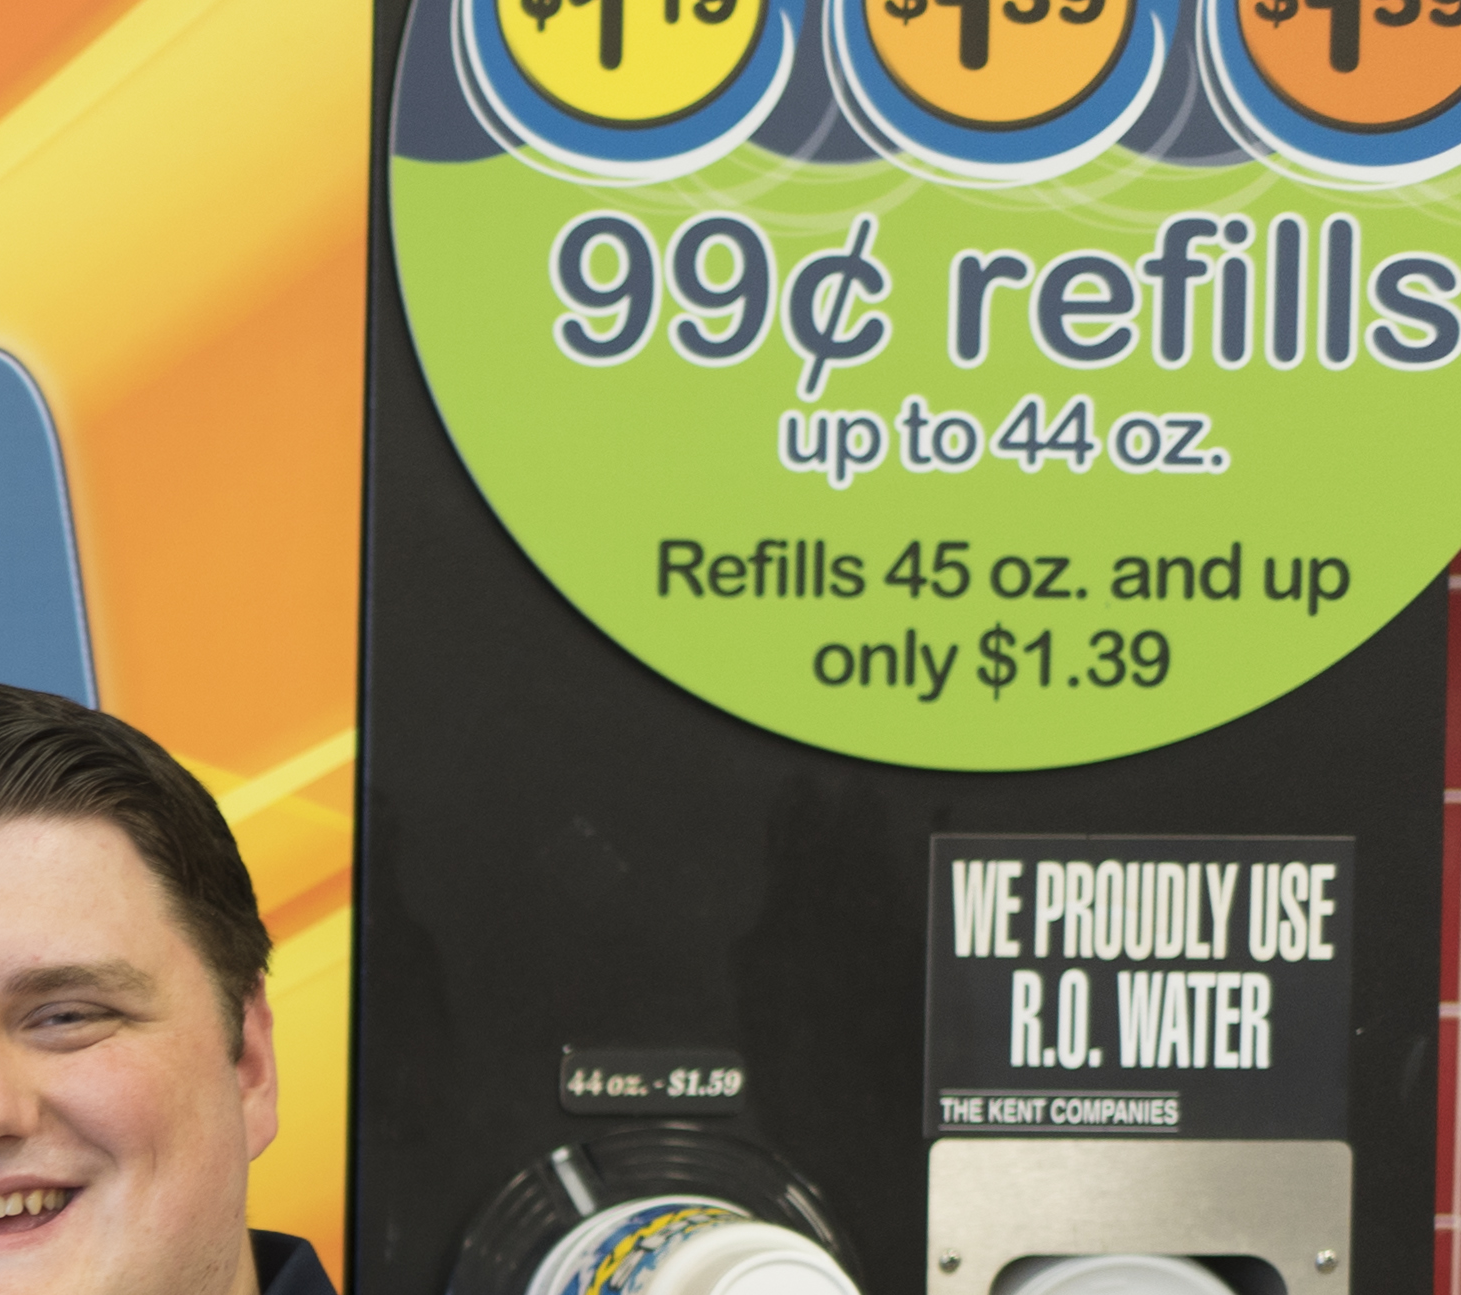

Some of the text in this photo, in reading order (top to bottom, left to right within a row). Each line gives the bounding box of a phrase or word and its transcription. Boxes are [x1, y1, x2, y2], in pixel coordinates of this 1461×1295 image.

[557, 216, 1461, 395] 99¢ refills
[787, 400, 1224, 482] up to 44 oz.
[657, 538, 1351, 617] Refills 45 oz. and up
[813, 624, 1173, 703] only $1.39
[951, 859, 1336, 963] WE PROUDLY USE
[1010, 969, 1272, 1071] R.O. WATER
[567, 1066, 606, 1098] 44
[607, 1074, 649, 1099] oz.
[667, 1066, 743, 1100] $1.59
[939, 1096, 1181, 1127] THE KENT COMPANIES
